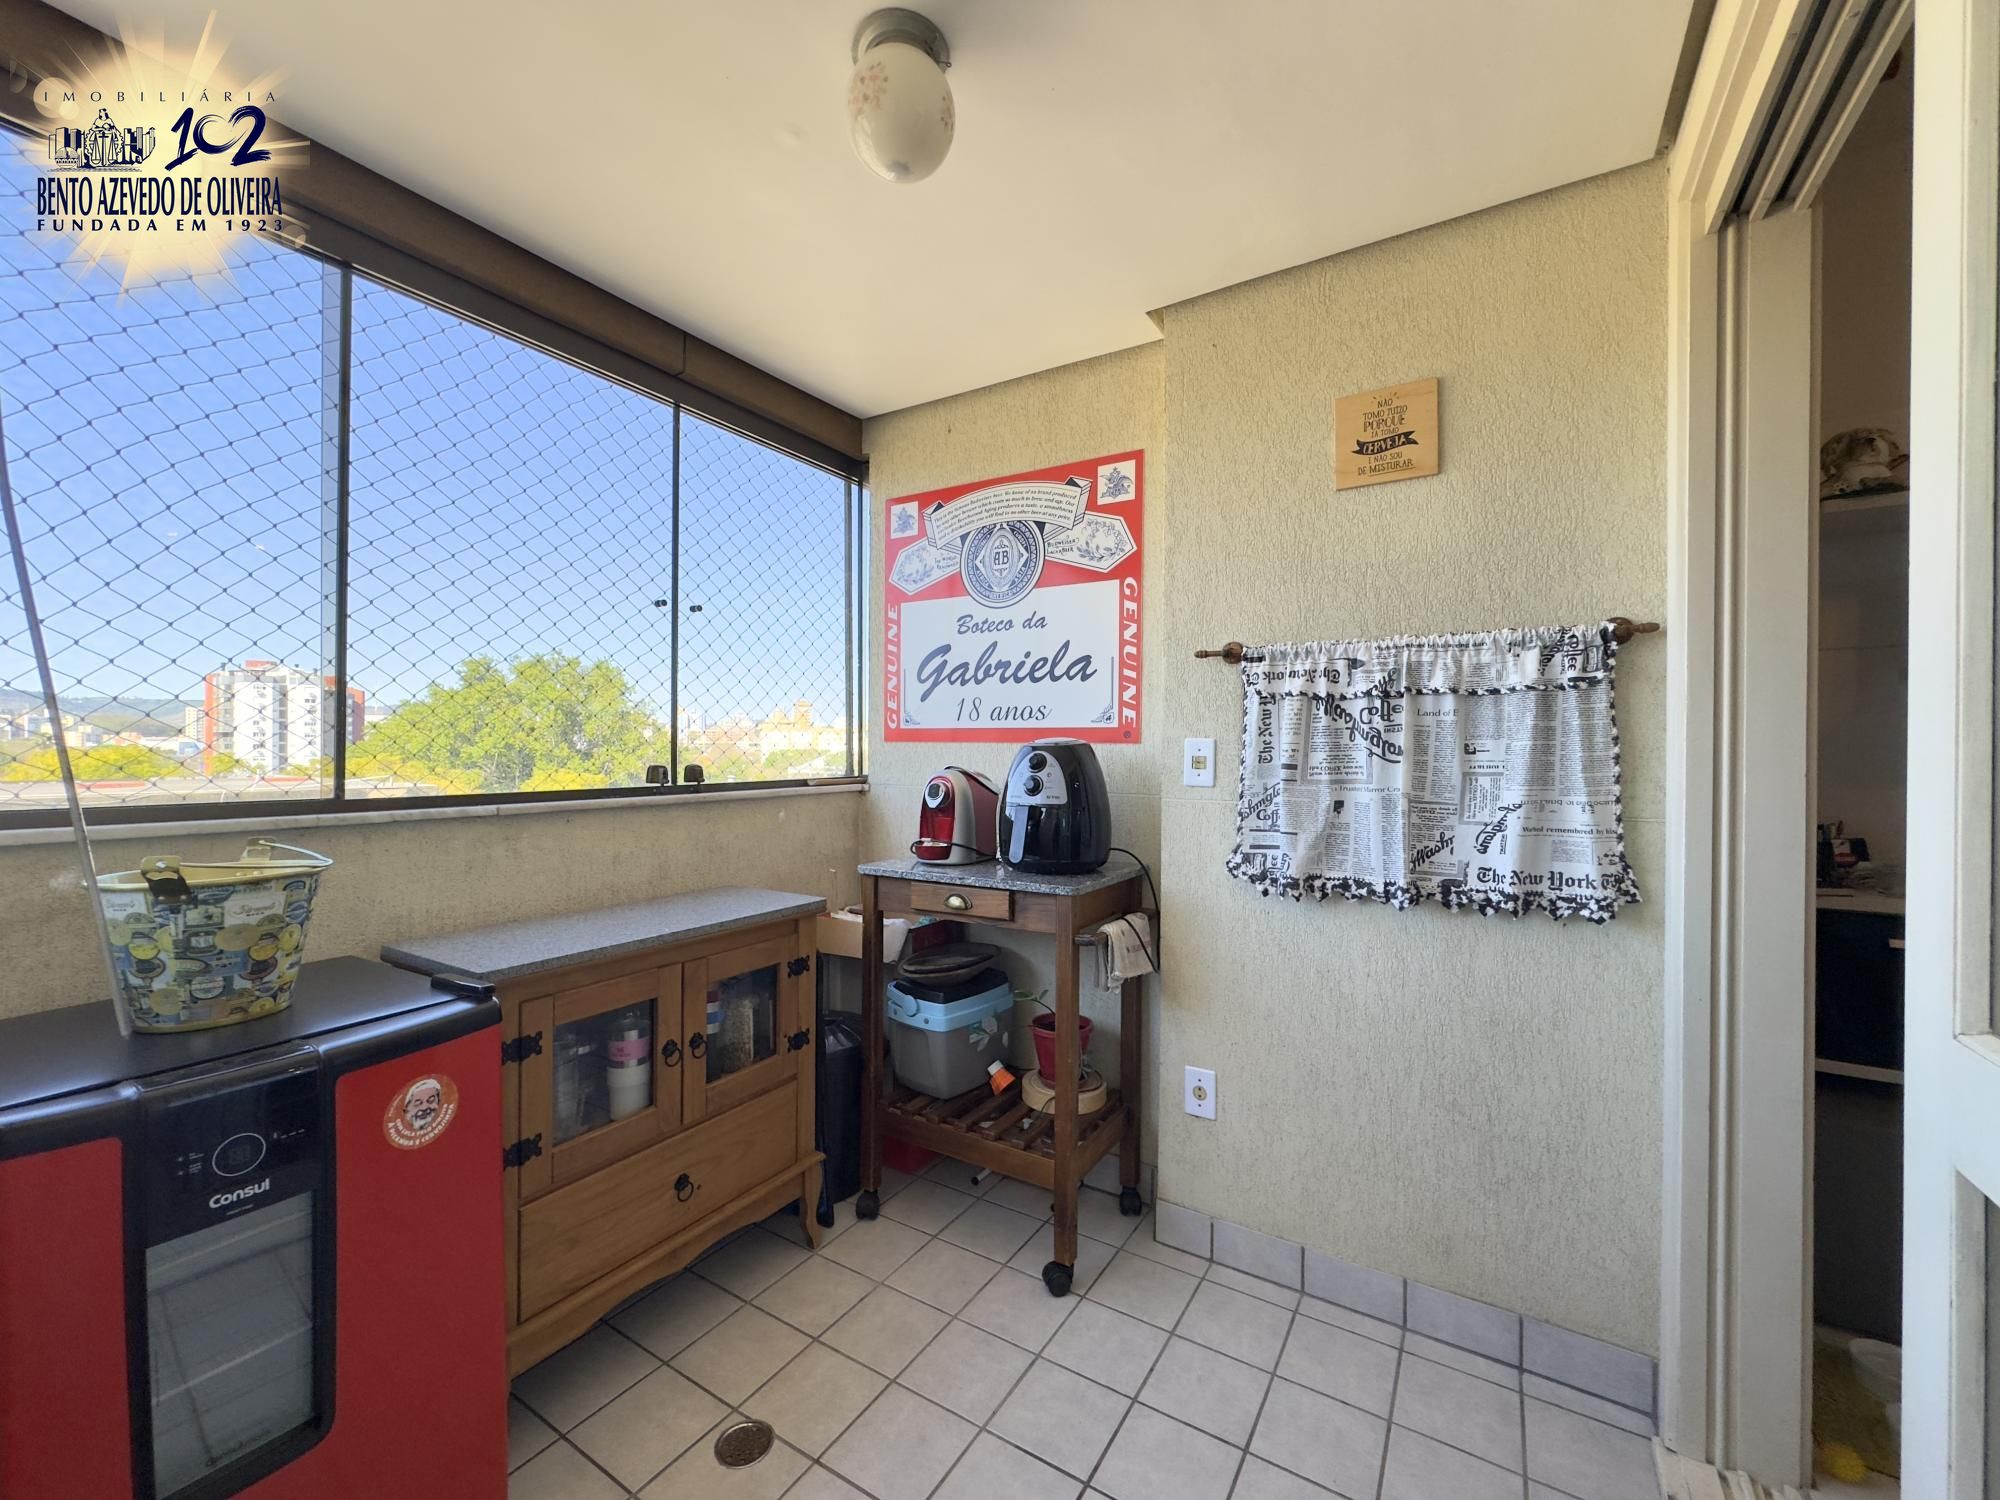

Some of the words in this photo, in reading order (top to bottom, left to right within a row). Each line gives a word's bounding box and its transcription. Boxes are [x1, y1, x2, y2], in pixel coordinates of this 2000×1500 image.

[1362, 409, 1385, 420] TOMO
[1364, 415, 1408, 432] PORQUE
[1363, 434, 1407, 454] CERVEJA
[1389, 451, 1403, 461] SOU
[1369, 458, 1414, 474] MISTURAR
[956, 614, 1014, 636] Boteco
[1022, 610, 1048, 630] da
[1123, 576, 1138, 728] GENUINE
[887, 604, 898, 730] GENUINE
[916, 639, 1098, 703] Gabriela
[1262, 666, 1287, 683] ork
[956, 696, 982, 722] 18
[989, 703, 1053, 722] anos
[1416, 708, 1440, 717] Land
[1258, 708, 1274, 738] New
[1258, 739, 1275, 764] The
[1476, 866, 1507, 886] The
[1509, 869, 1545, 887] New
[1547, 870, 1598, 892] York
[208, 1177, 270, 1208] Consul
